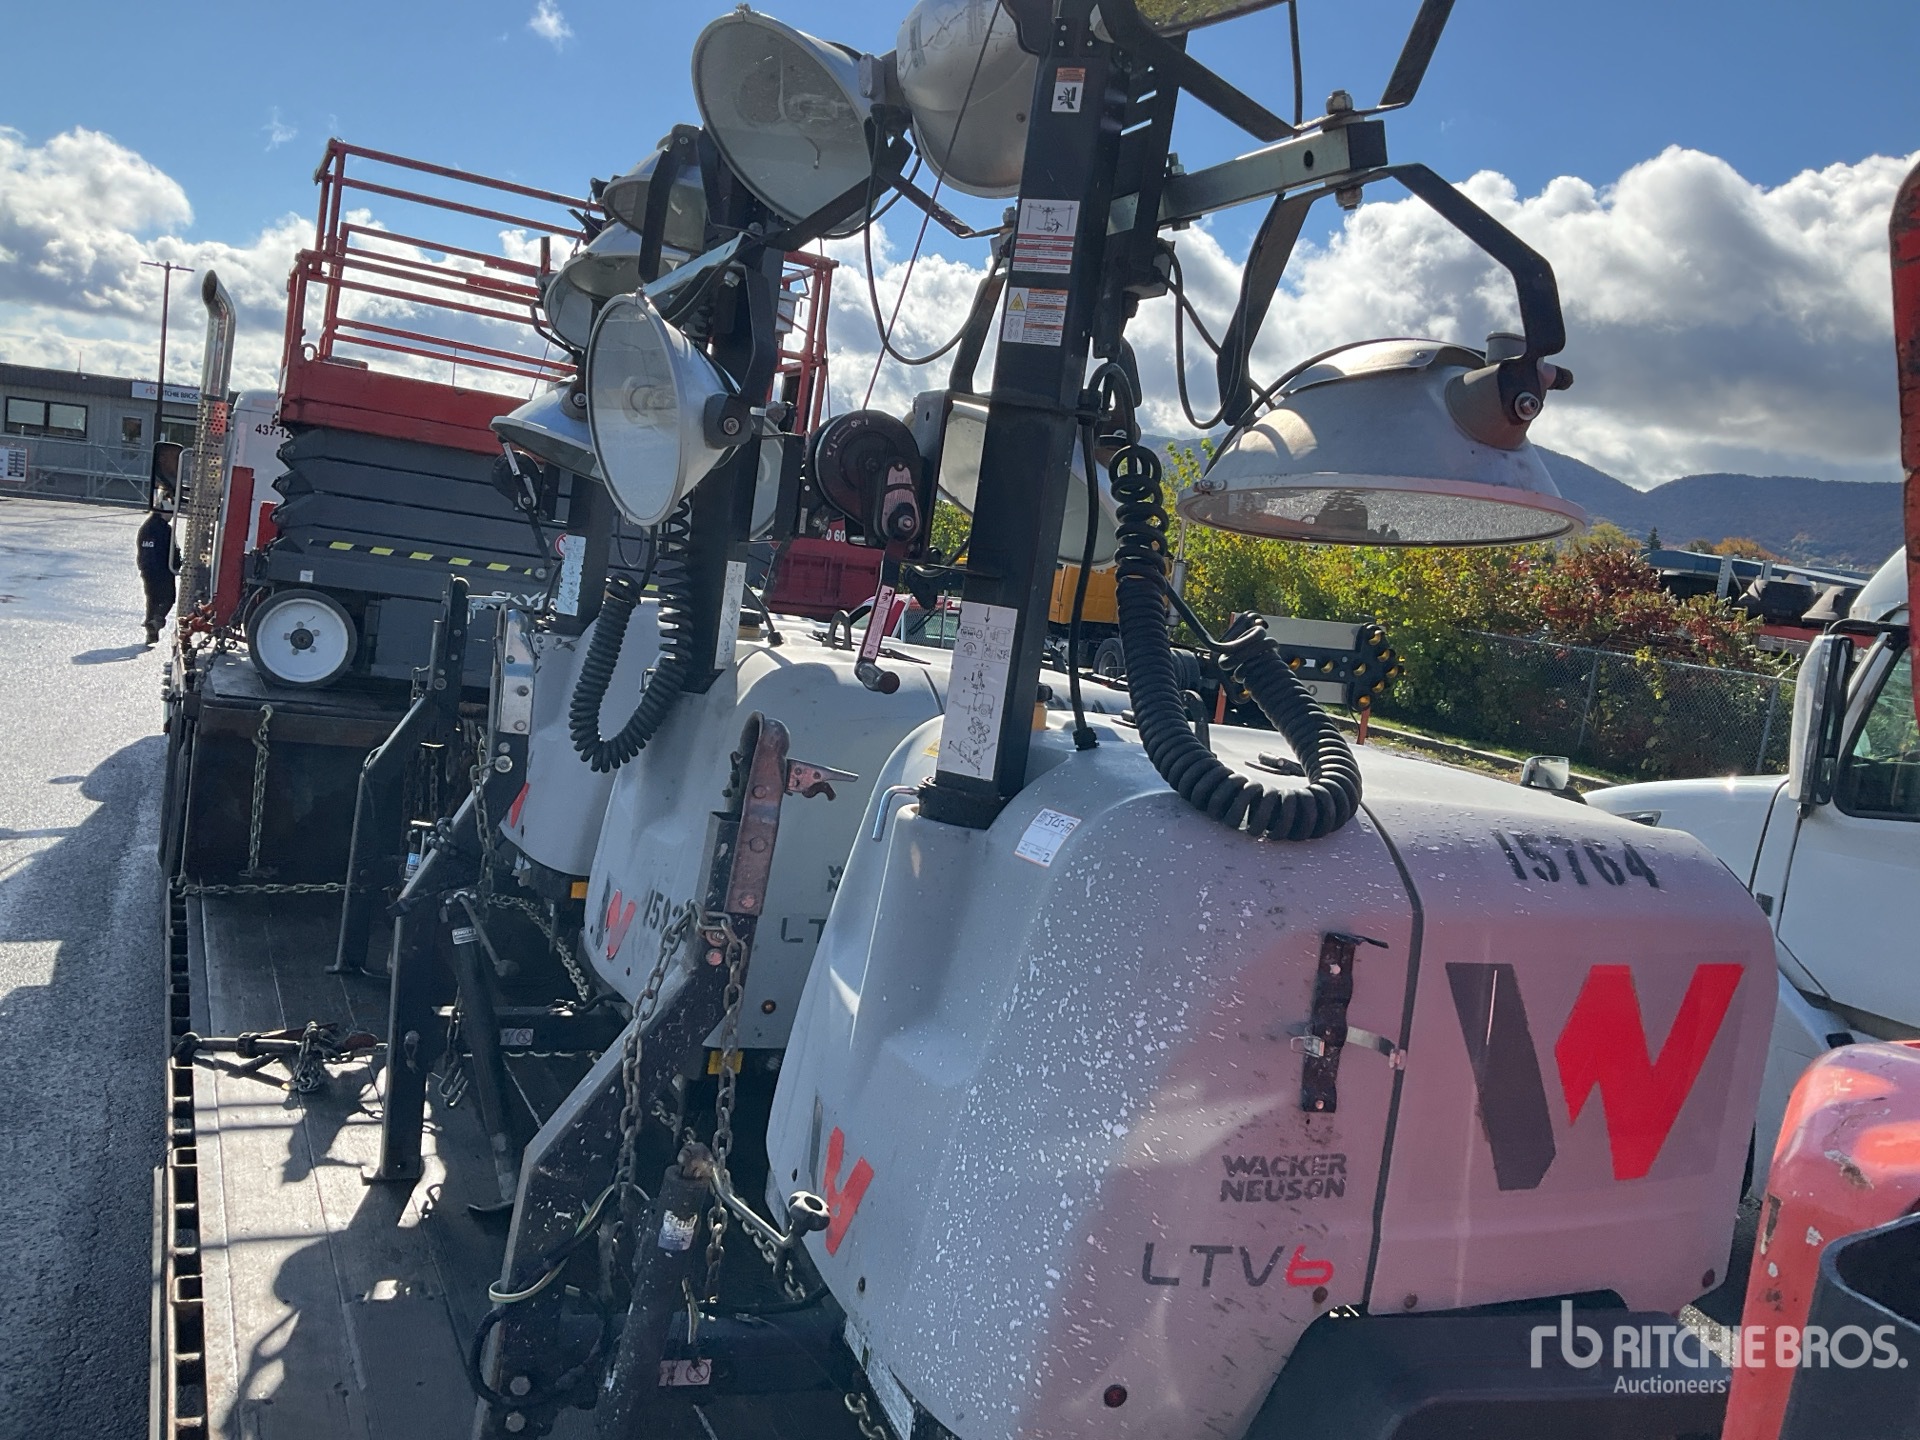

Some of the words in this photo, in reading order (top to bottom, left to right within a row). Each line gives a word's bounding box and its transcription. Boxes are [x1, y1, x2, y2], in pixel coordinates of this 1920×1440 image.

[1489, 829, 1660, 888] 15764
[1222, 1153, 1347, 1178] WACKER
[1220, 1177, 1347, 1203] NEUSON
[1142, 1242, 1334, 1287] LTV6
